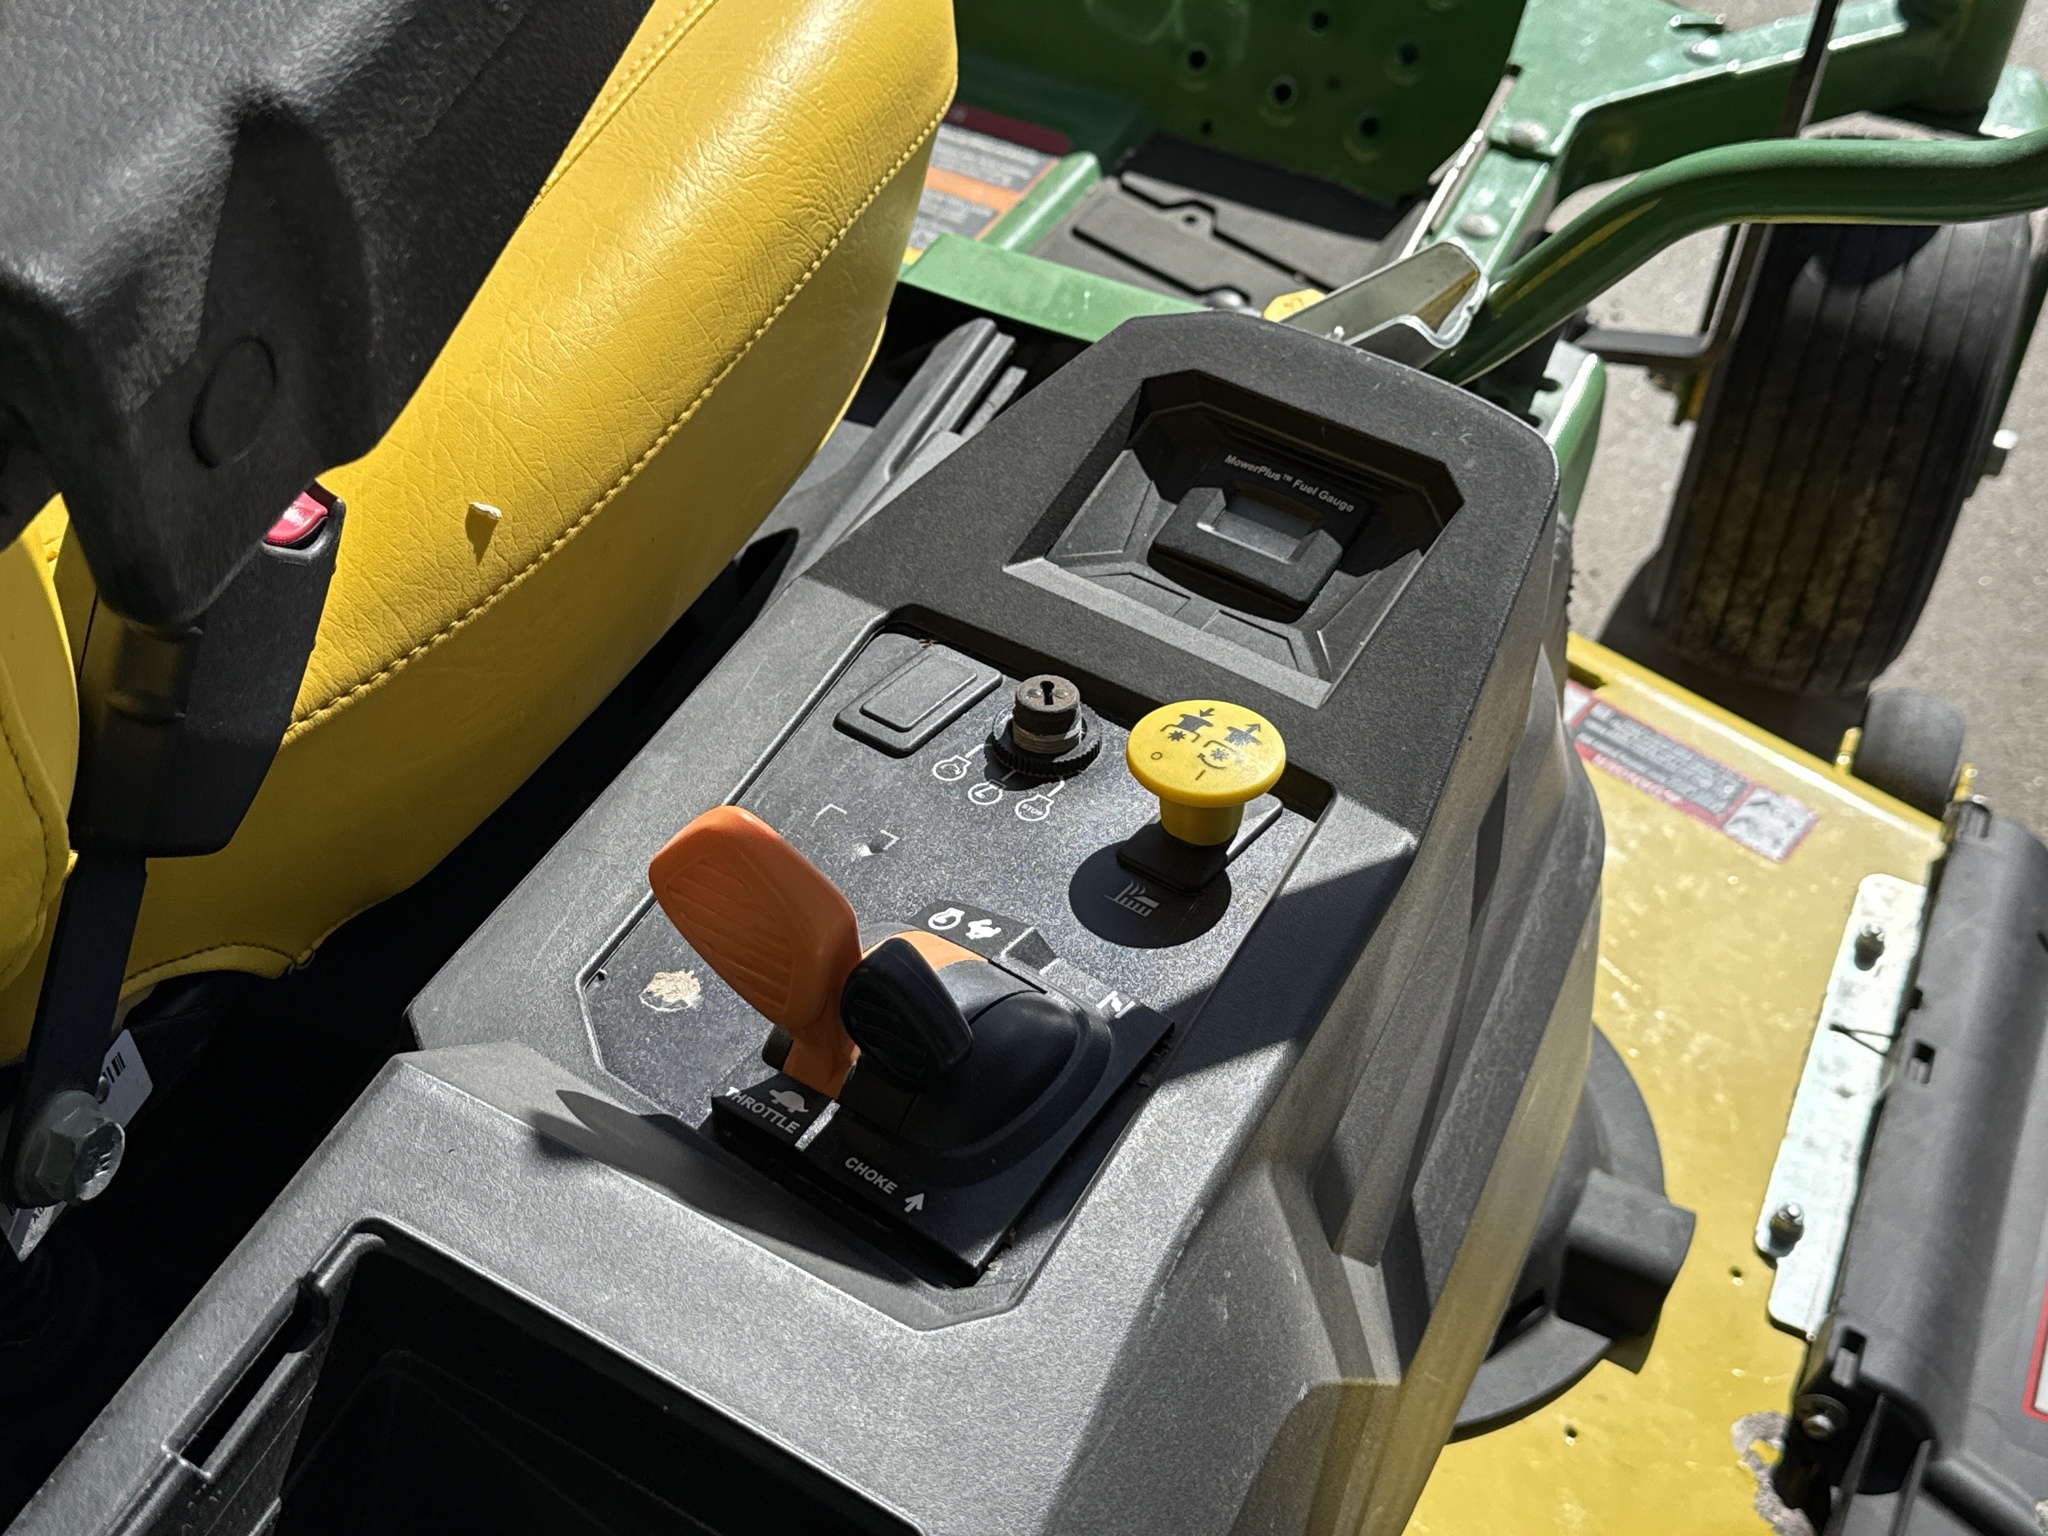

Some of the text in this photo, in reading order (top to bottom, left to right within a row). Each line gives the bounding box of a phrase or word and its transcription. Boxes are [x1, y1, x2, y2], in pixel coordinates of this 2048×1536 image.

[1292, 479, 1318, 496] Fuel
[1318, 490, 1355, 513] Gauge
[1020, 803, 1043, 816] STOP
[726, 1086, 801, 1134] THROTTLE
[845, 1157, 898, 1194] CHOKE
